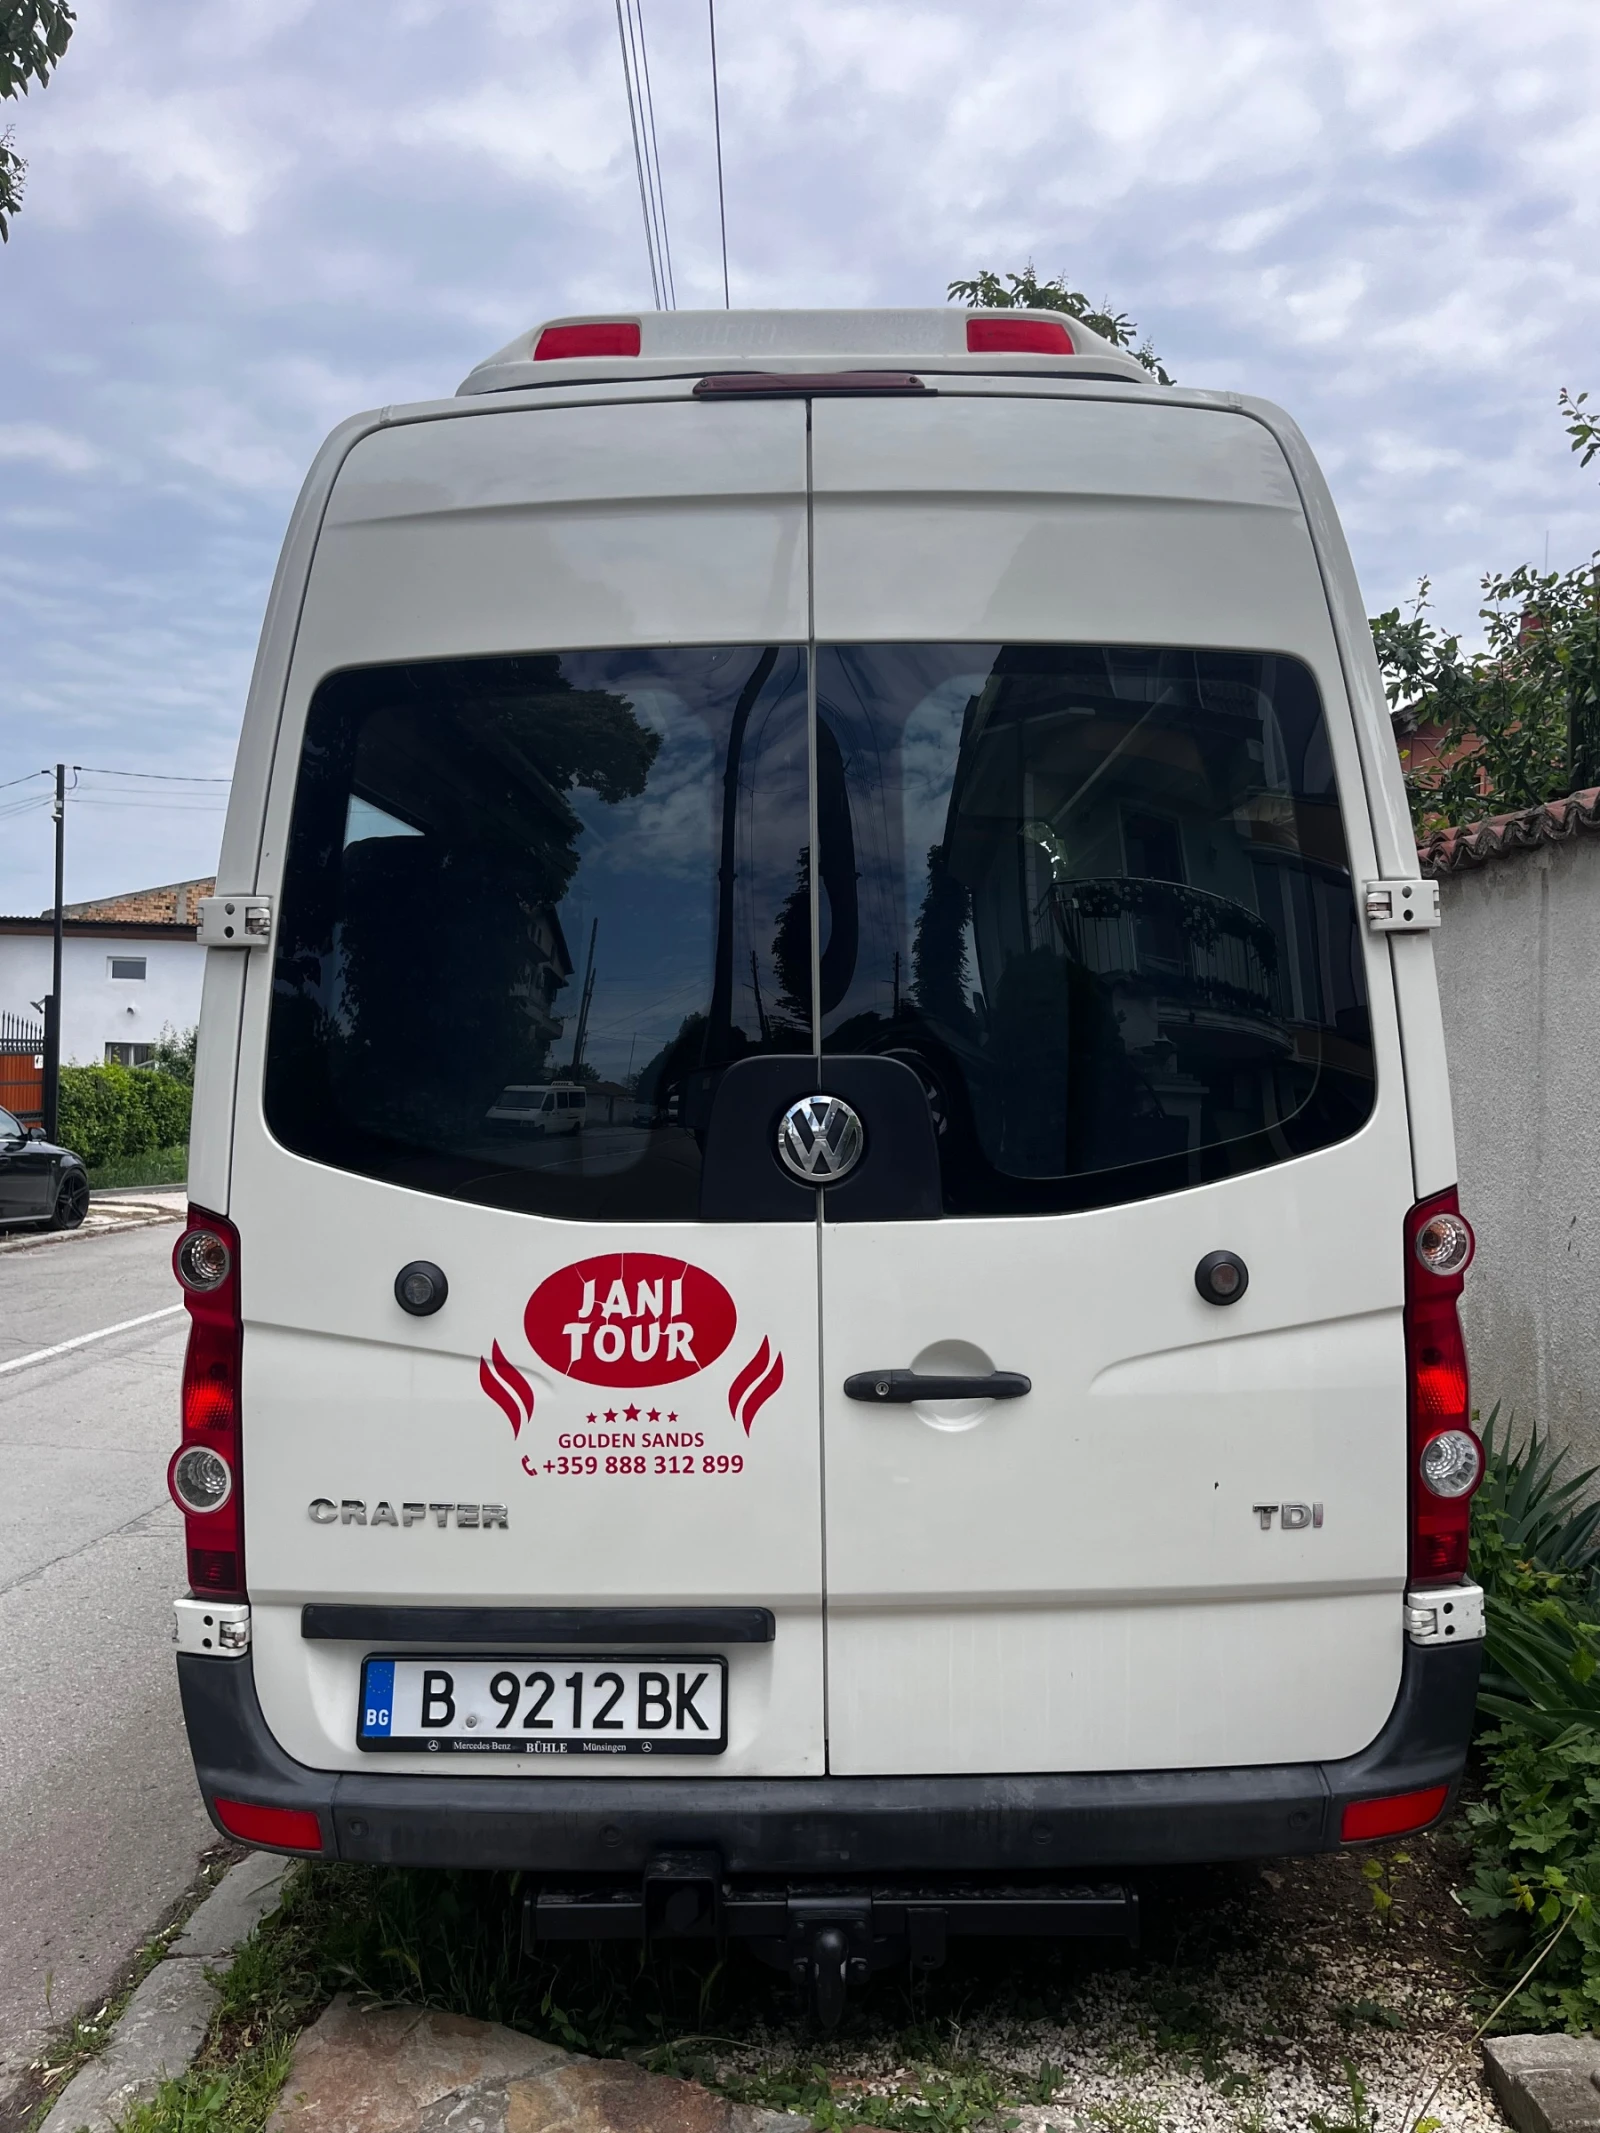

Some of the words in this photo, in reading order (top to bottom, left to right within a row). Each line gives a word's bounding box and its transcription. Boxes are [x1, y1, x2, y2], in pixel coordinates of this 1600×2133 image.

[578, 1275, 683, 1319] JANI
[562, 1321, 697, 1363] TOUR
[558, 1433, 636, 1449] GOLDEN
[642, 1432, 705, 1448] SANDS
[543, 1456, 598, 1475] +359
[605, 1456, 647, 1475] 888
[654, 1456, 695, 1474] 312
[702, 1455, 744, 1474] 899
[308, 1497, 509, 1530] CRAFTER
[1252, 1502, 1323, 1530] TDI
[366, 1708, 390, 1726] BG
[525, 1741, 568, 1754] BÜHLE
[582, 1742, 627, 1753] Münsingen
